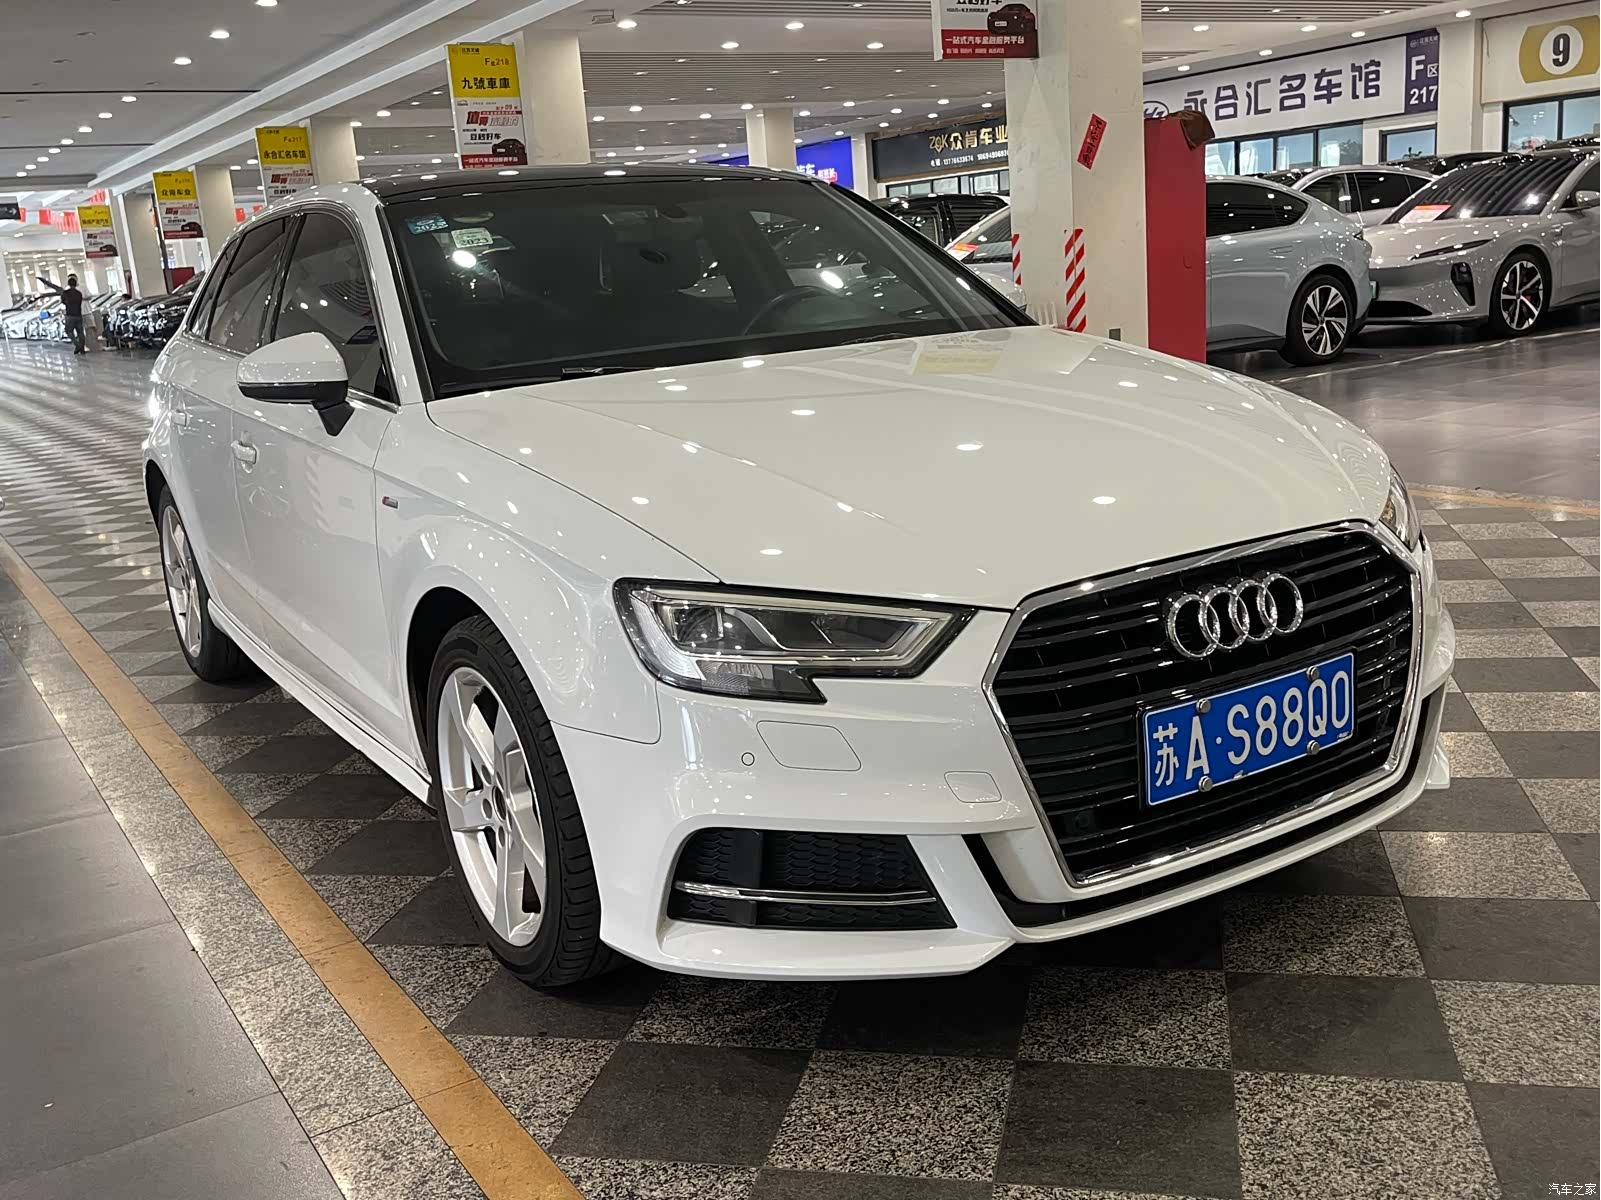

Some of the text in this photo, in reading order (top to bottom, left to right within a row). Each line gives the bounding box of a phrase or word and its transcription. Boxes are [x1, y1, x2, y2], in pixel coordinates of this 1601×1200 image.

[1552, 33, 1571, 67] 9
[461, 77, 511, 90] 九號車庫
[1410, 85, 1438, 104] 217
